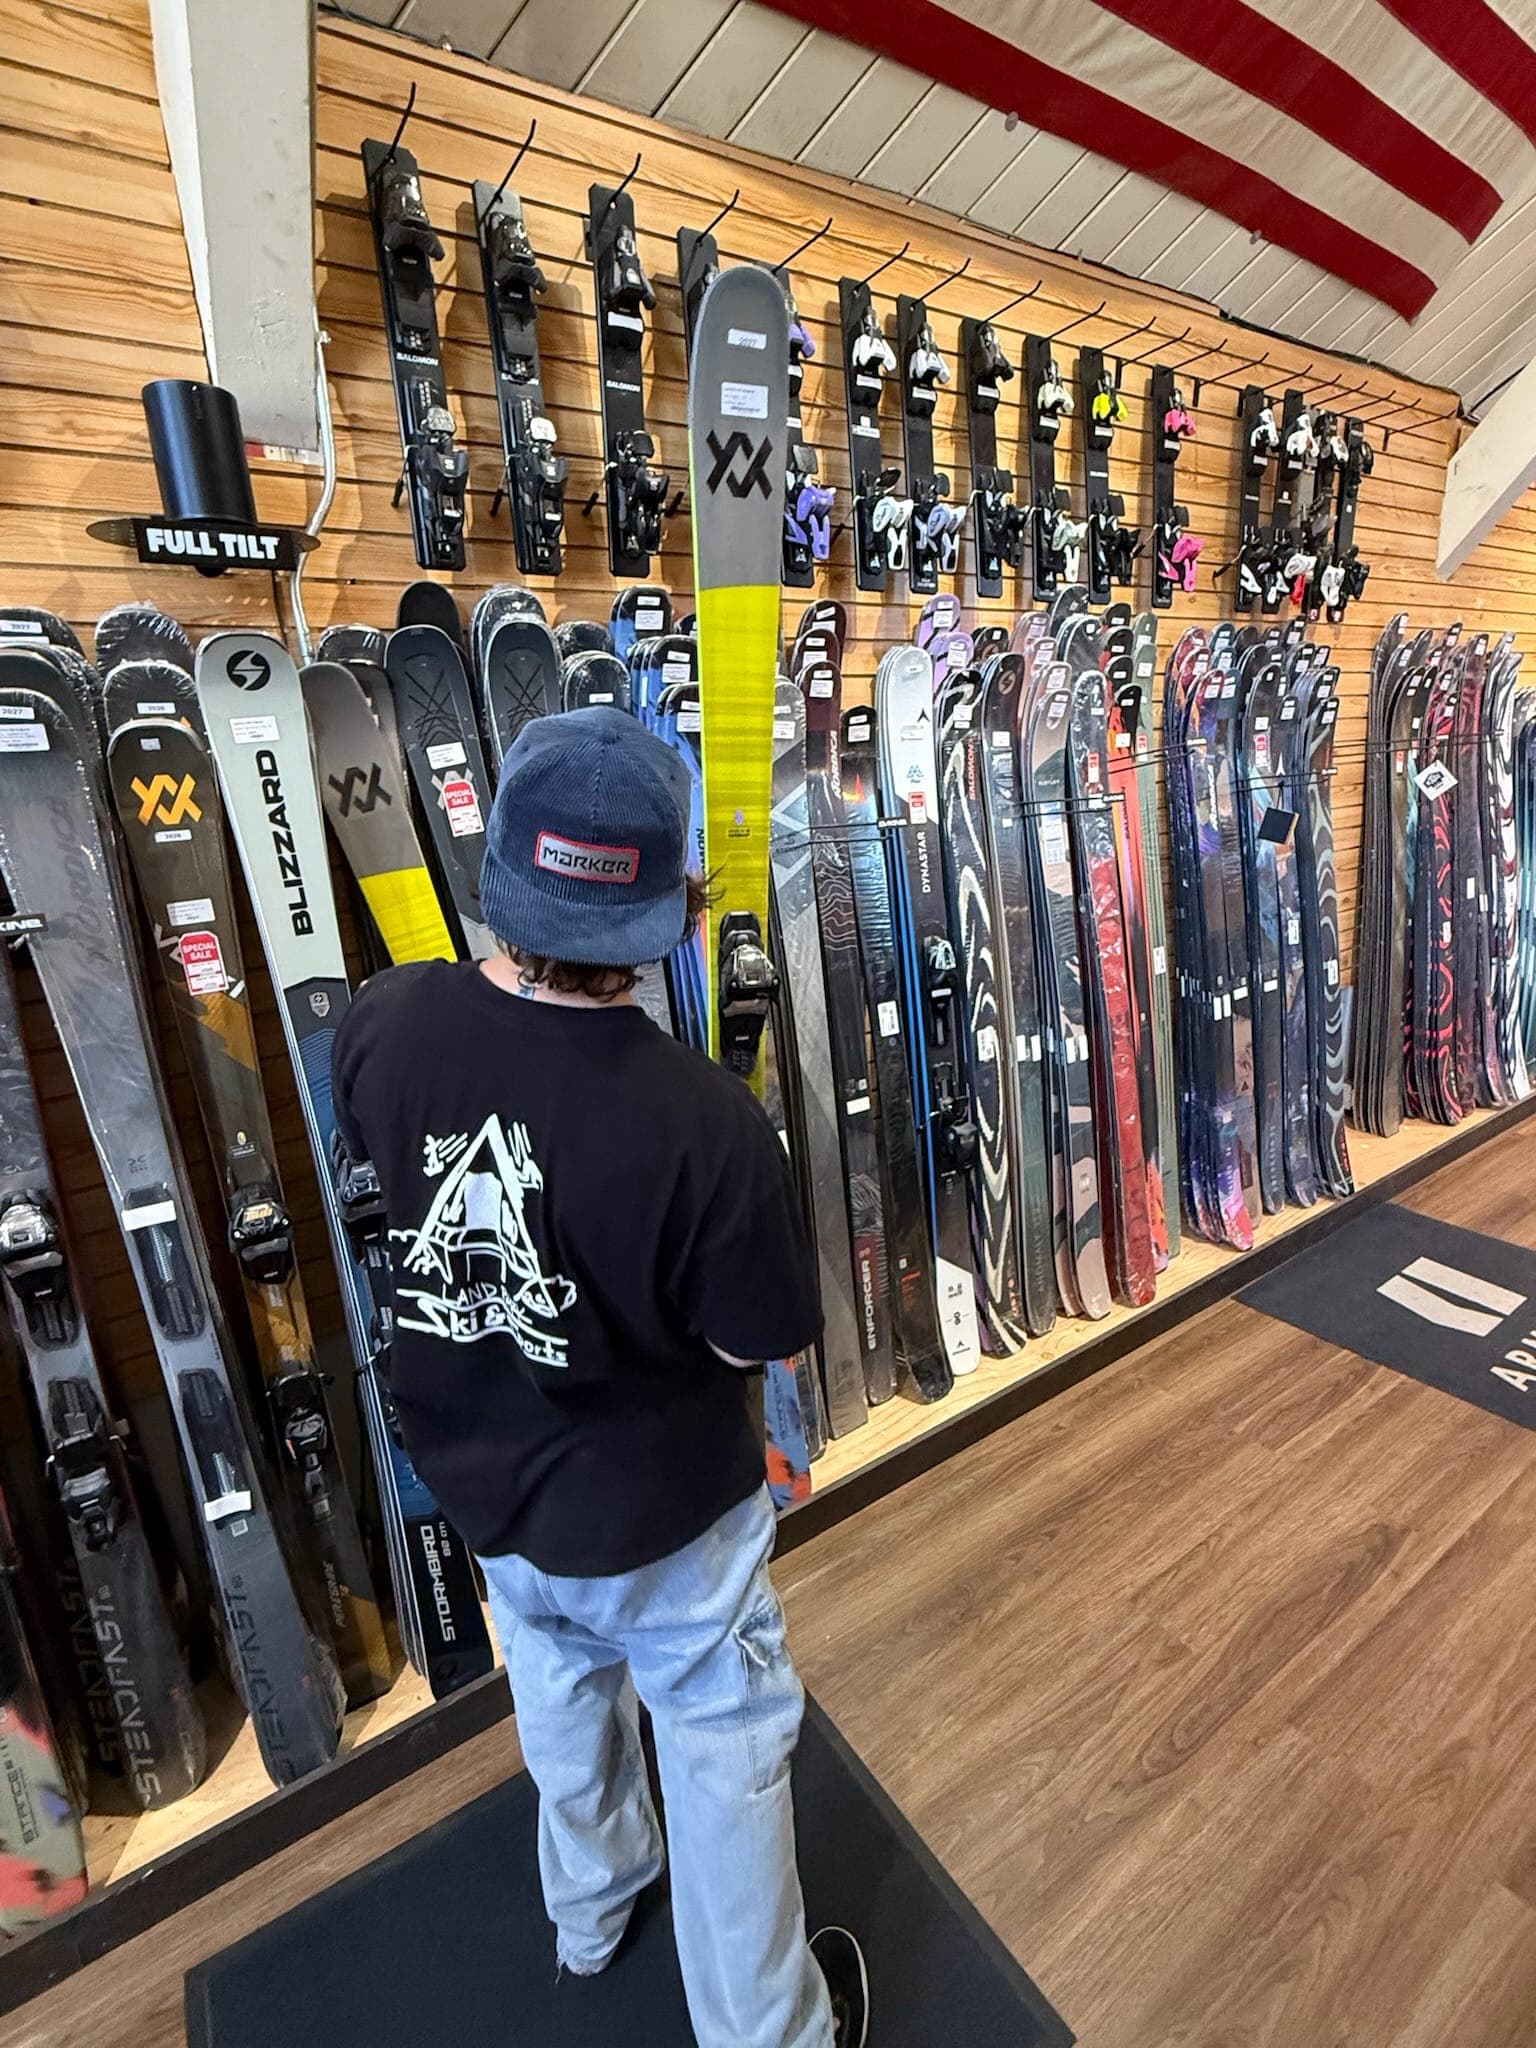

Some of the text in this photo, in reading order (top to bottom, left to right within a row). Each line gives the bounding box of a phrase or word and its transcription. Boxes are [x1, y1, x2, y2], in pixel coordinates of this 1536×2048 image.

[396, 352, 439, 367] SALOMON
[146, 527, 281, 560] FULL TILT
[830, 730, 842, 799] NORDICA
[968, 741, 977, 800] SALOMON
[1121, 786, 1131, 840] SALOMN
[255, 749, 315, 937] BLIZZARD
[543, 846, 632, 876] MARKER
[917, 831, 931, 894] DYNASTAR
[189, 949, 213, 961] SALE
[861, 1259, 877, 1350] ENFORCER
[420, 1525, 456, 1642] STORMBIRD
